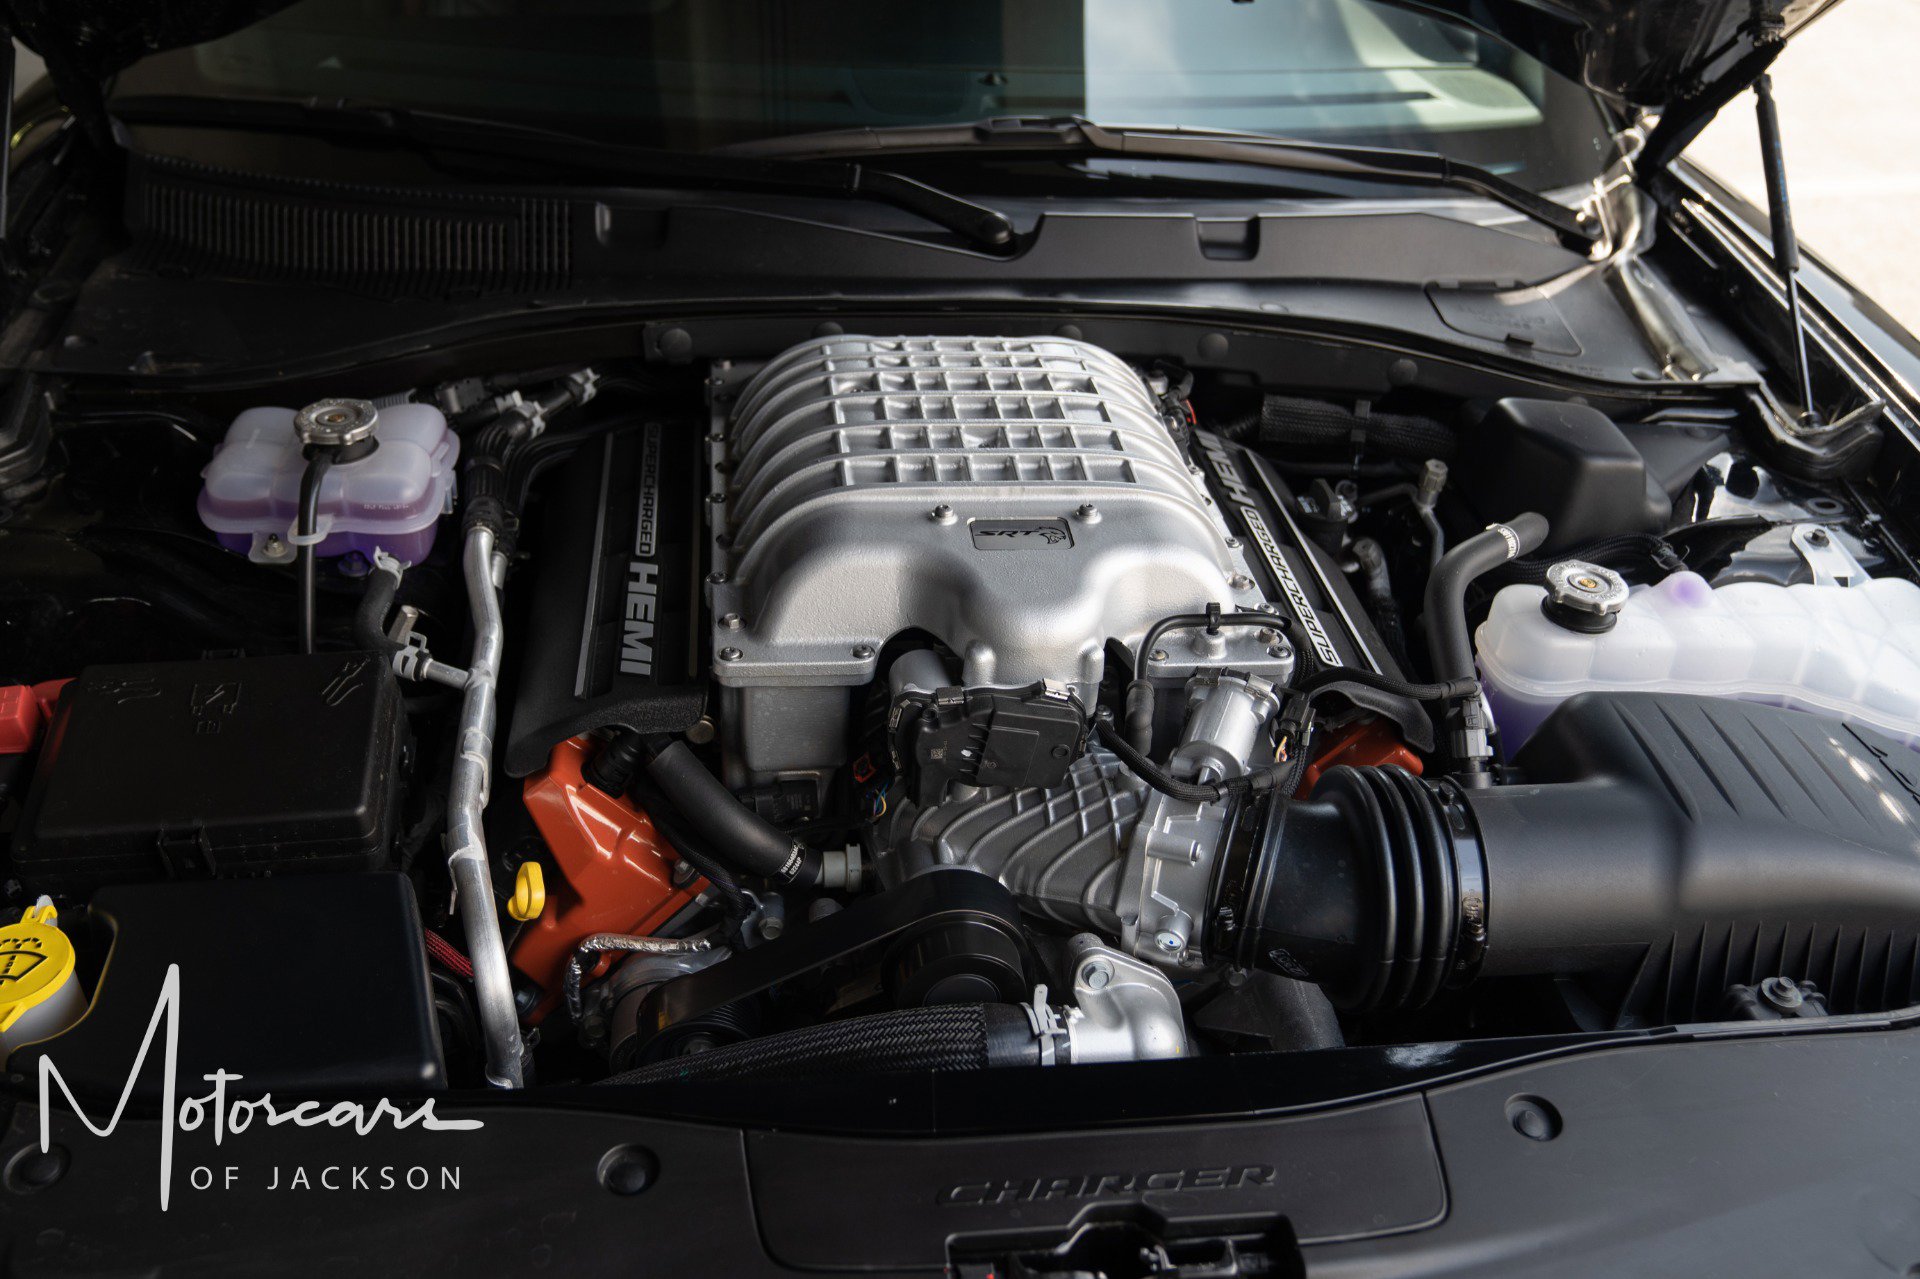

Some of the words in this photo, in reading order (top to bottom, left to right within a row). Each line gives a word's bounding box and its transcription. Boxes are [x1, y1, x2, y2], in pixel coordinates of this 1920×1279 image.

[637, 423, 660, 555] SUPERCHARGED
[1194, 430, 1256, 508] HEMI
[974, 530, 1039, 538] SRT
[620, 562, 658, 675] HEMI
[1244, 507, 1341, 668] SUPERCHARGED
[936, 1165, 1276, 1206] CHARGER
